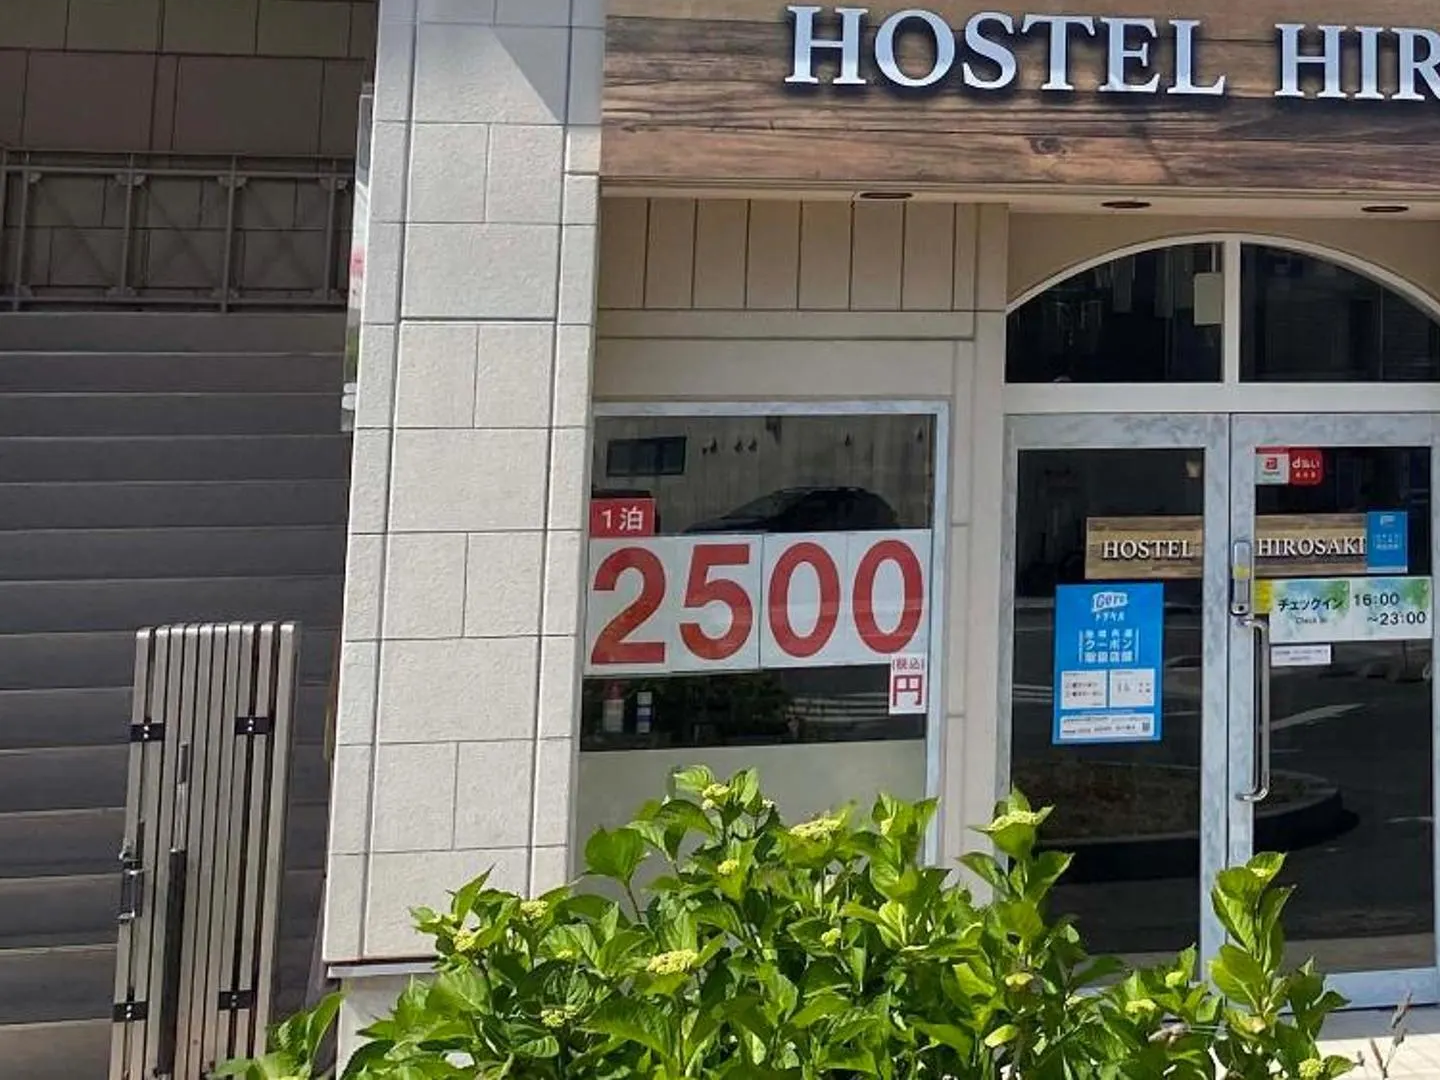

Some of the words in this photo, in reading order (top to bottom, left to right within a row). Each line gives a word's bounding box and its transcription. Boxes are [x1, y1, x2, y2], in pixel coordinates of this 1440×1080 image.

[784, 4, 1226, 97] HOSTEL
[600, 508, 644, 532] 1泊
[1102, 539, 1195, 561] HOSTEL
[1257, 536, 1367, 557] HIROSAKI
[590, 539, 926, 666] 2500
[1277, 598, 1344, 613] チェックイン
[1354, 591, 1401, 608] 16:00
[892, 674, 923, 707] 円
